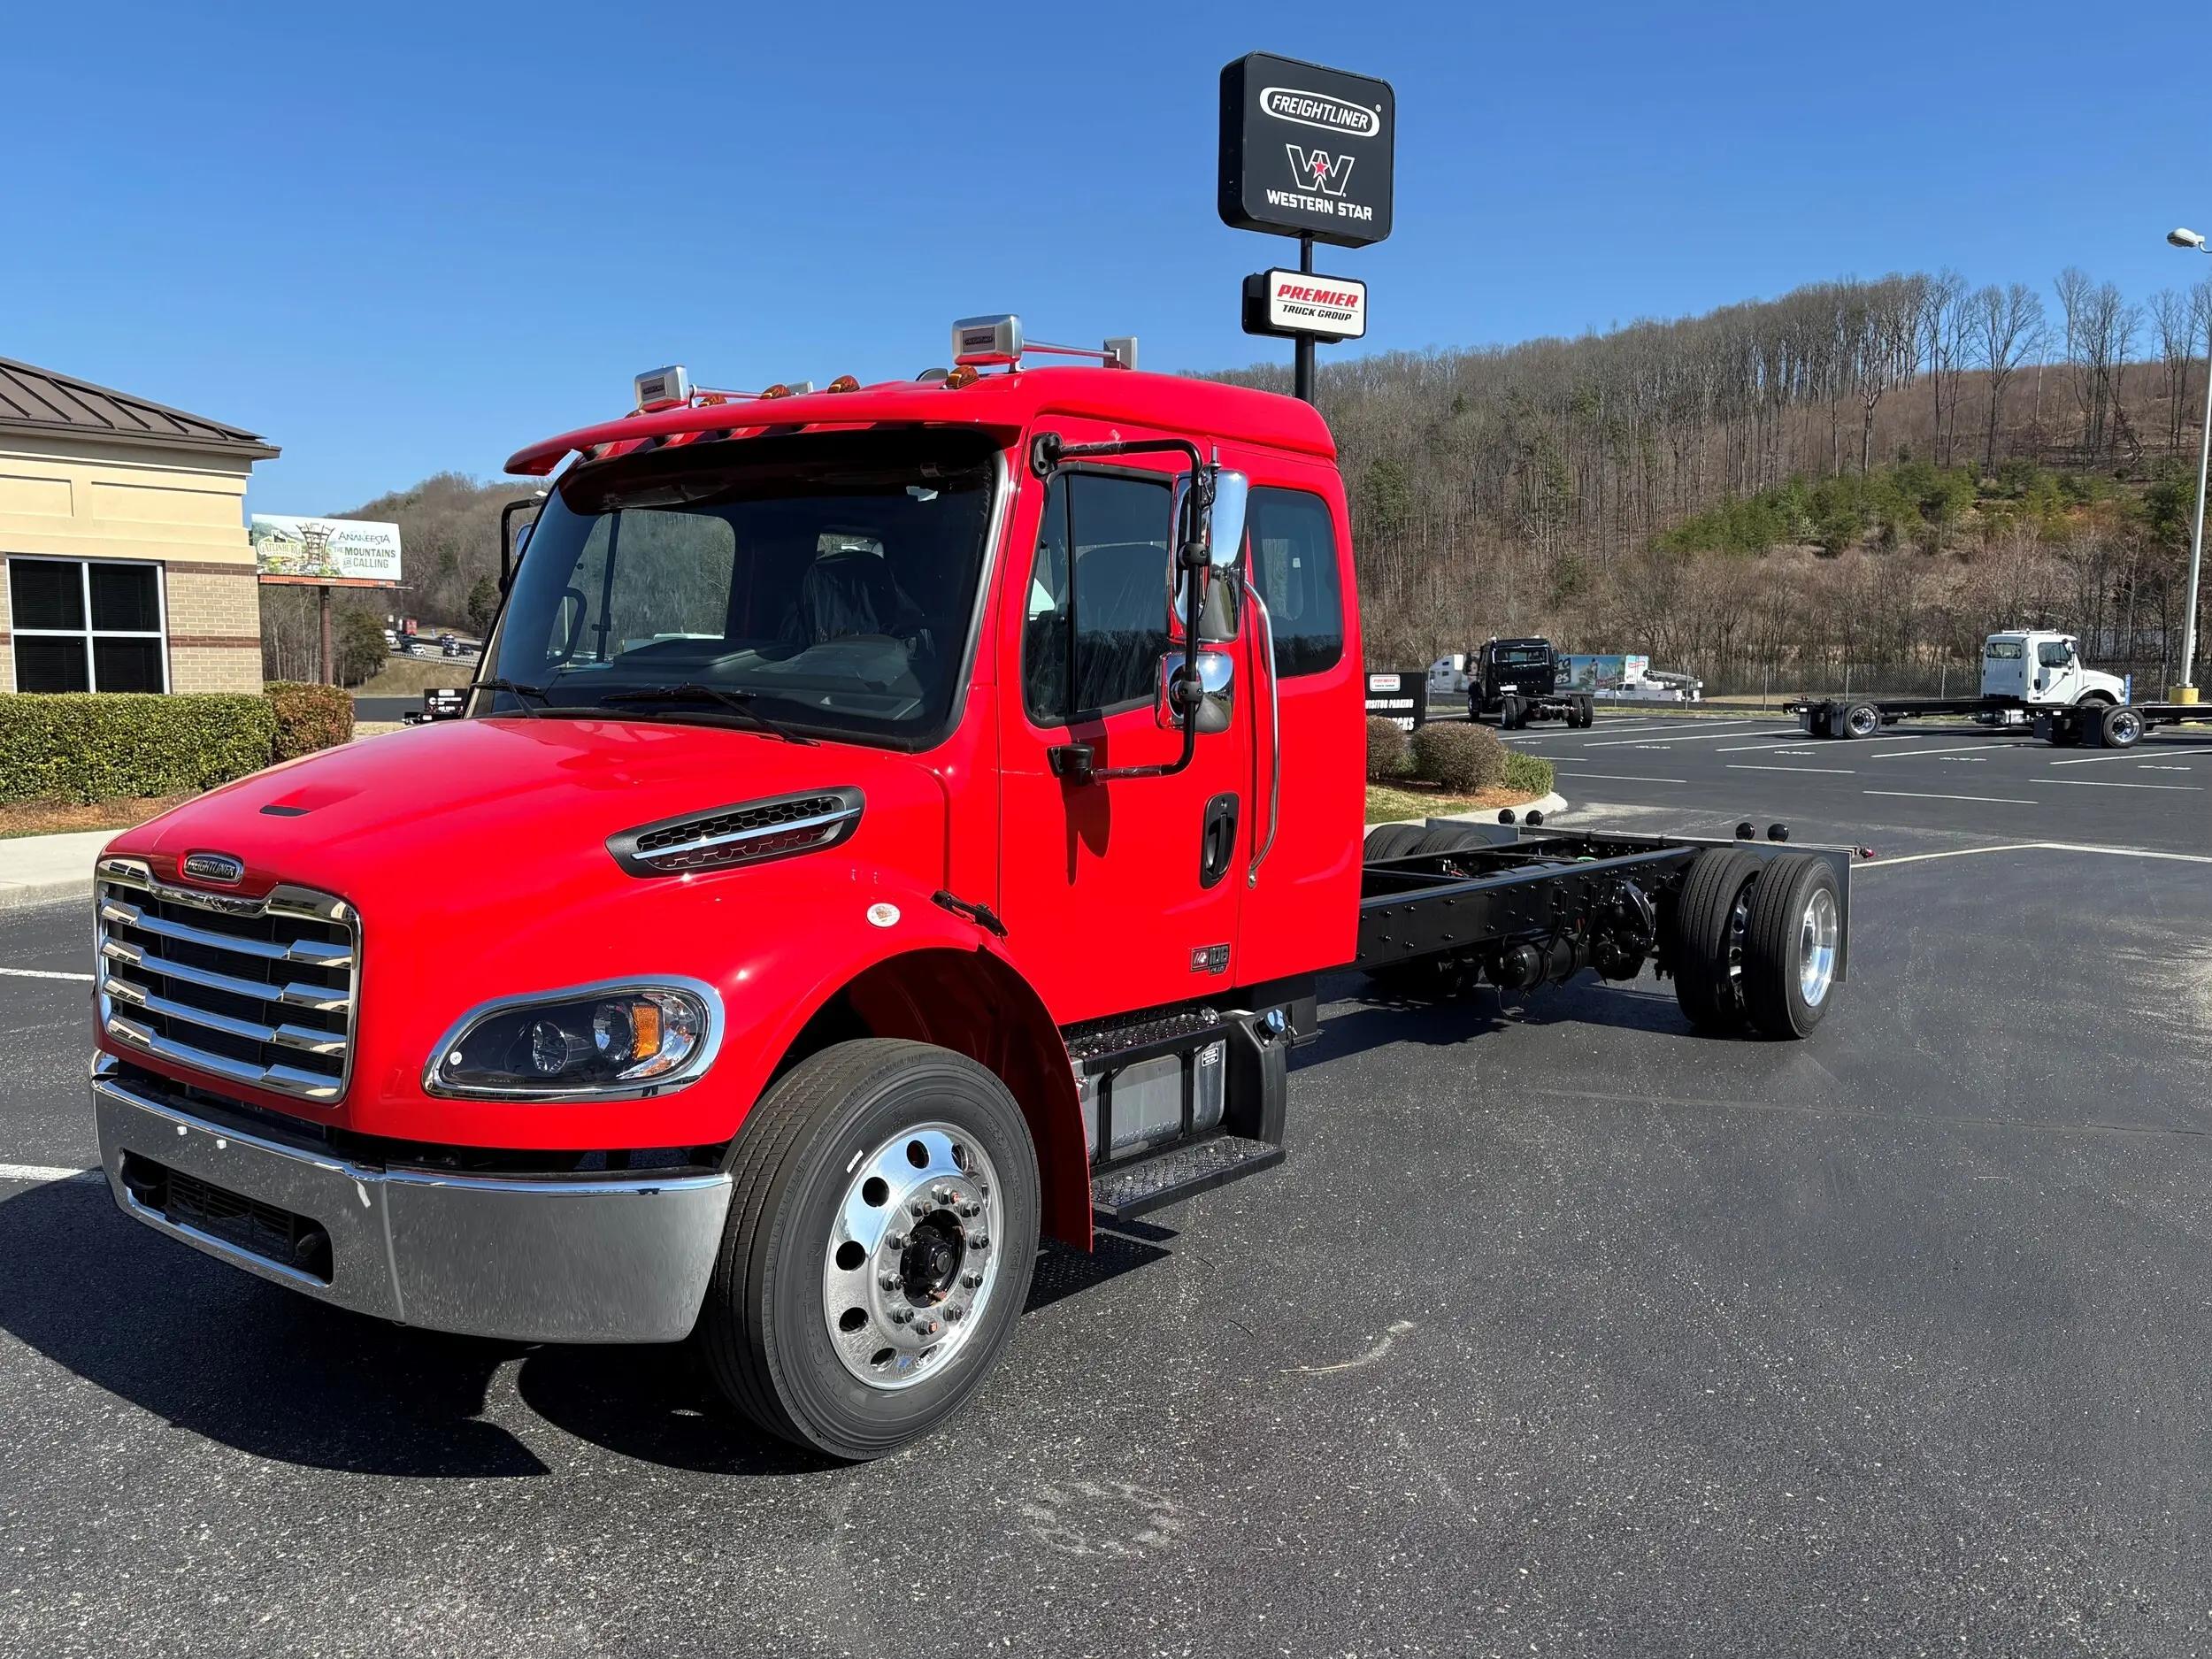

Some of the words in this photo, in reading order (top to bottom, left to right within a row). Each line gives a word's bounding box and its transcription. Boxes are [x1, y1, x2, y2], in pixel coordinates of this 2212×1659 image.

[1271, 95, 1369, 129] FREIGHTLINER
[1266, 188, 1333, 214] WESTERN
[1338, 202, 1372, 220] STAR
[1277, 284, 1358, 307] PREMIER
[1282, 304, 1315, 317] TRUCK
[1317, 310, 1352, 321] GROUP
[344, 547, 396, 557] MOUNTAINS
[353, 557, 388, 568] CALLING
[1365, 700, 1388, 709] VISITOR
[1389, 699, 1414, 709] PARKING
